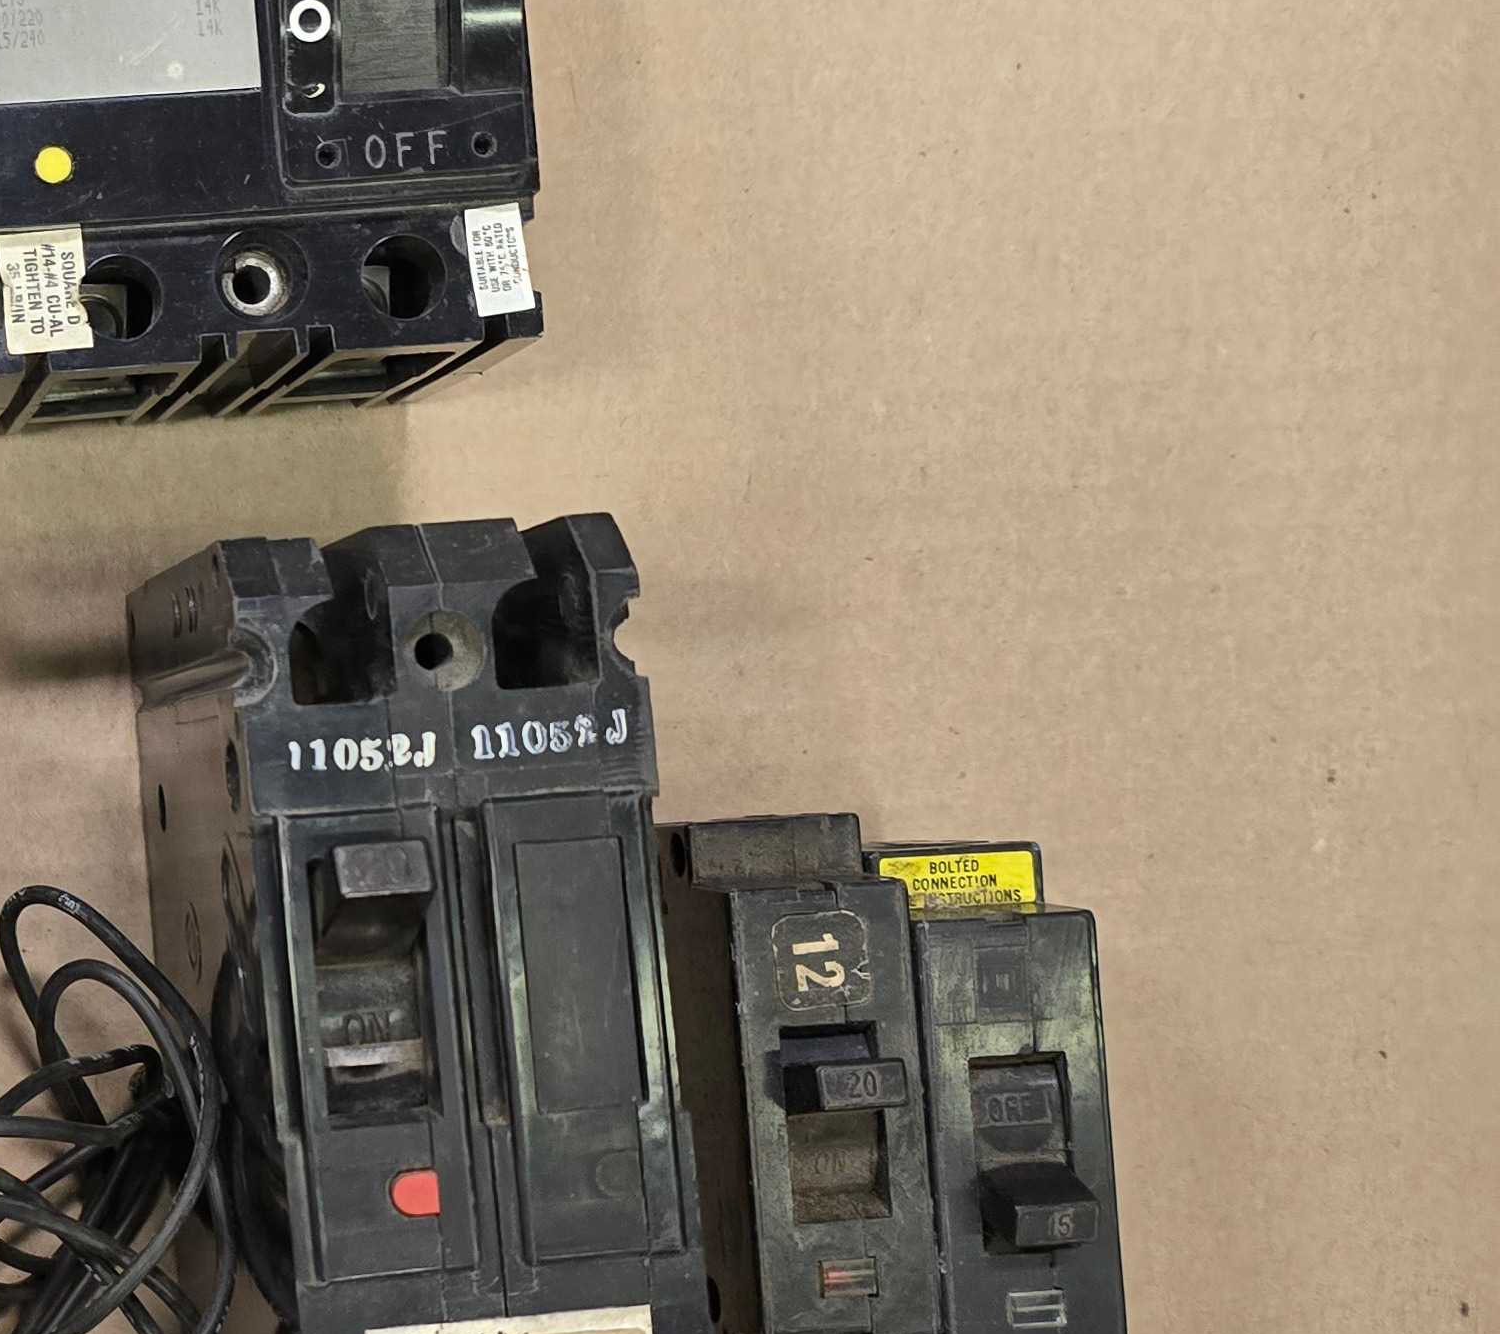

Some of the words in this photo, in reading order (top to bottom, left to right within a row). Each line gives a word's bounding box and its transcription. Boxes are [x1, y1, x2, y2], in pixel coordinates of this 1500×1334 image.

[364, 130, 448, 168] OFF
[22, 248, 42, 311] TIGHTEN
[30, 316, 45, 335] TO
[67, 315, 81, 325] D
[929, 859, 979, 874] BOLTED
[913, 874, 997, 891] CONNECTION
[792, 932, 847, 993] 12
[847, 1071, 878, 1098] 20
